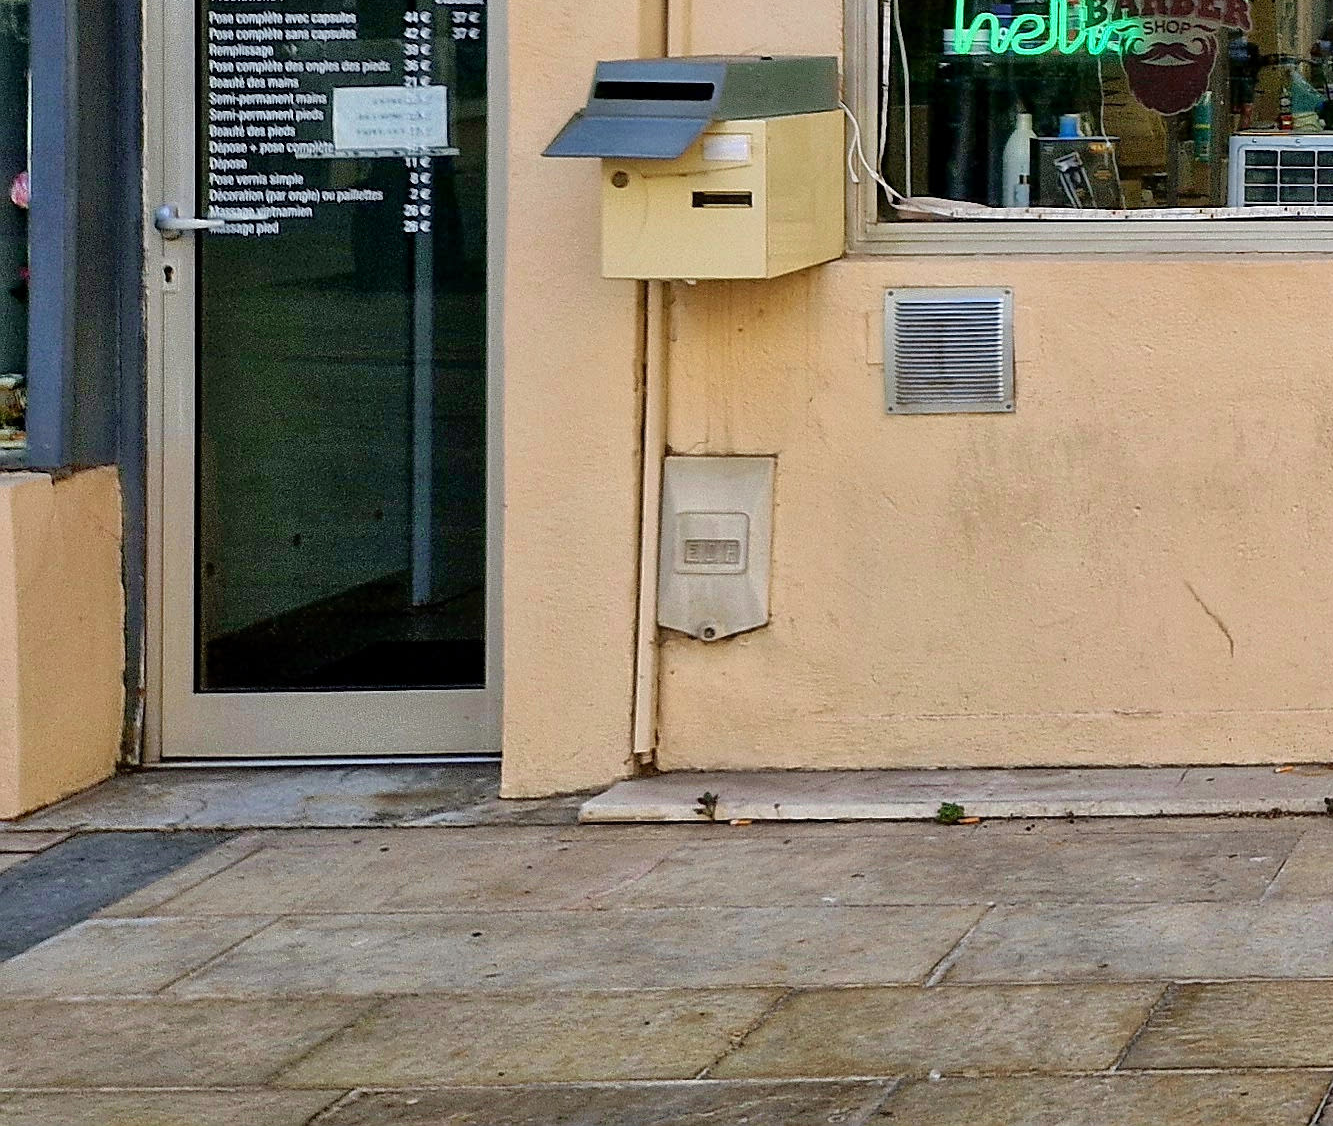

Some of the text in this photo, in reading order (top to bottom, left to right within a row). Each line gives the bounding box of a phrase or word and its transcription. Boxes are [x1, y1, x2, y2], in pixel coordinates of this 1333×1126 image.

[209, 10, 234, 24] Pose
[209, 27, 234, 41] Pose
[1144, 20, 1190, 35] SHOP
[209, 43, 274, 58] Remplissage
[209, 59, 234, 73] Pose
[285, 60, 304, 72] des
[305, 60, 340, 74] ongles
[341, 60, 361, 72] des
[362, 60, 391, 74] pieds
[246, 76, 266, 88] des
[267, 76, 300, 88] mains
[295, 92, 328, 105] mains
[295, 109, 324, 122] pieds
[246, 125, 266, 137] des
[267, 125, 296, 139] pieds
[259, 143, 285, 156] pose
[209, 173, 235, 186] Pose
[236, 173, 268, 185] vernis
[269, 173, 304, 188] simple
[322, 192, 336, 202] ou
[256, 221, 279, 235] pied
